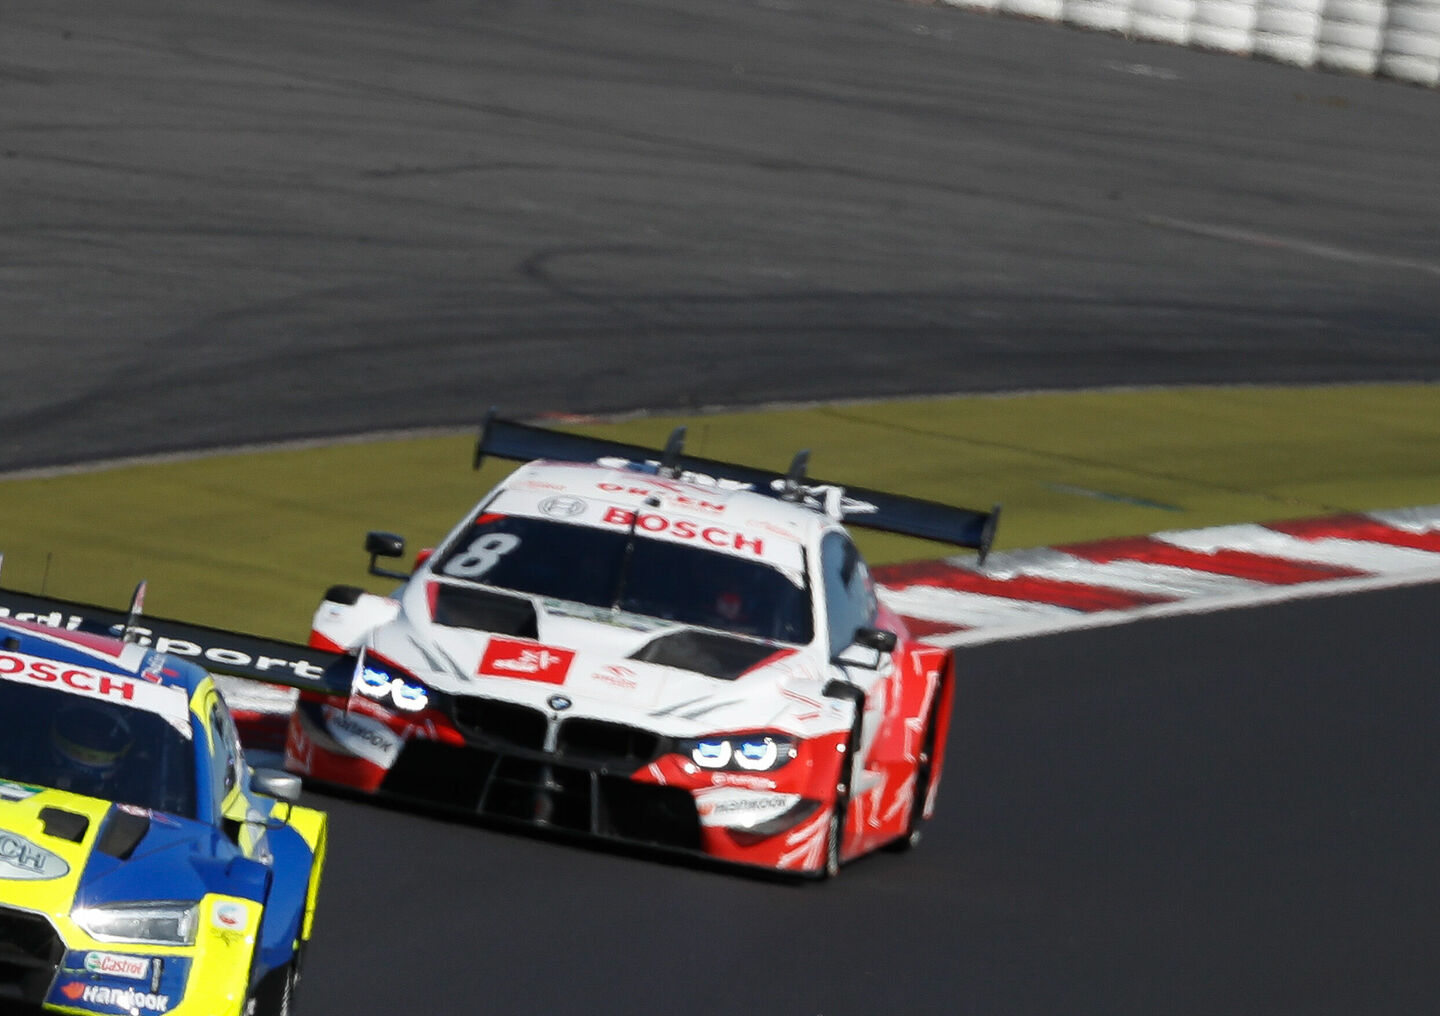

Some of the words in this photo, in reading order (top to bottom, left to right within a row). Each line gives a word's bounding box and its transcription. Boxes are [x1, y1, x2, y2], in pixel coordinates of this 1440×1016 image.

[602, 506, 764, 555] BOSCH
[444, 532, 522, 577] 8
[100, 956, 144, 976] Castrol
